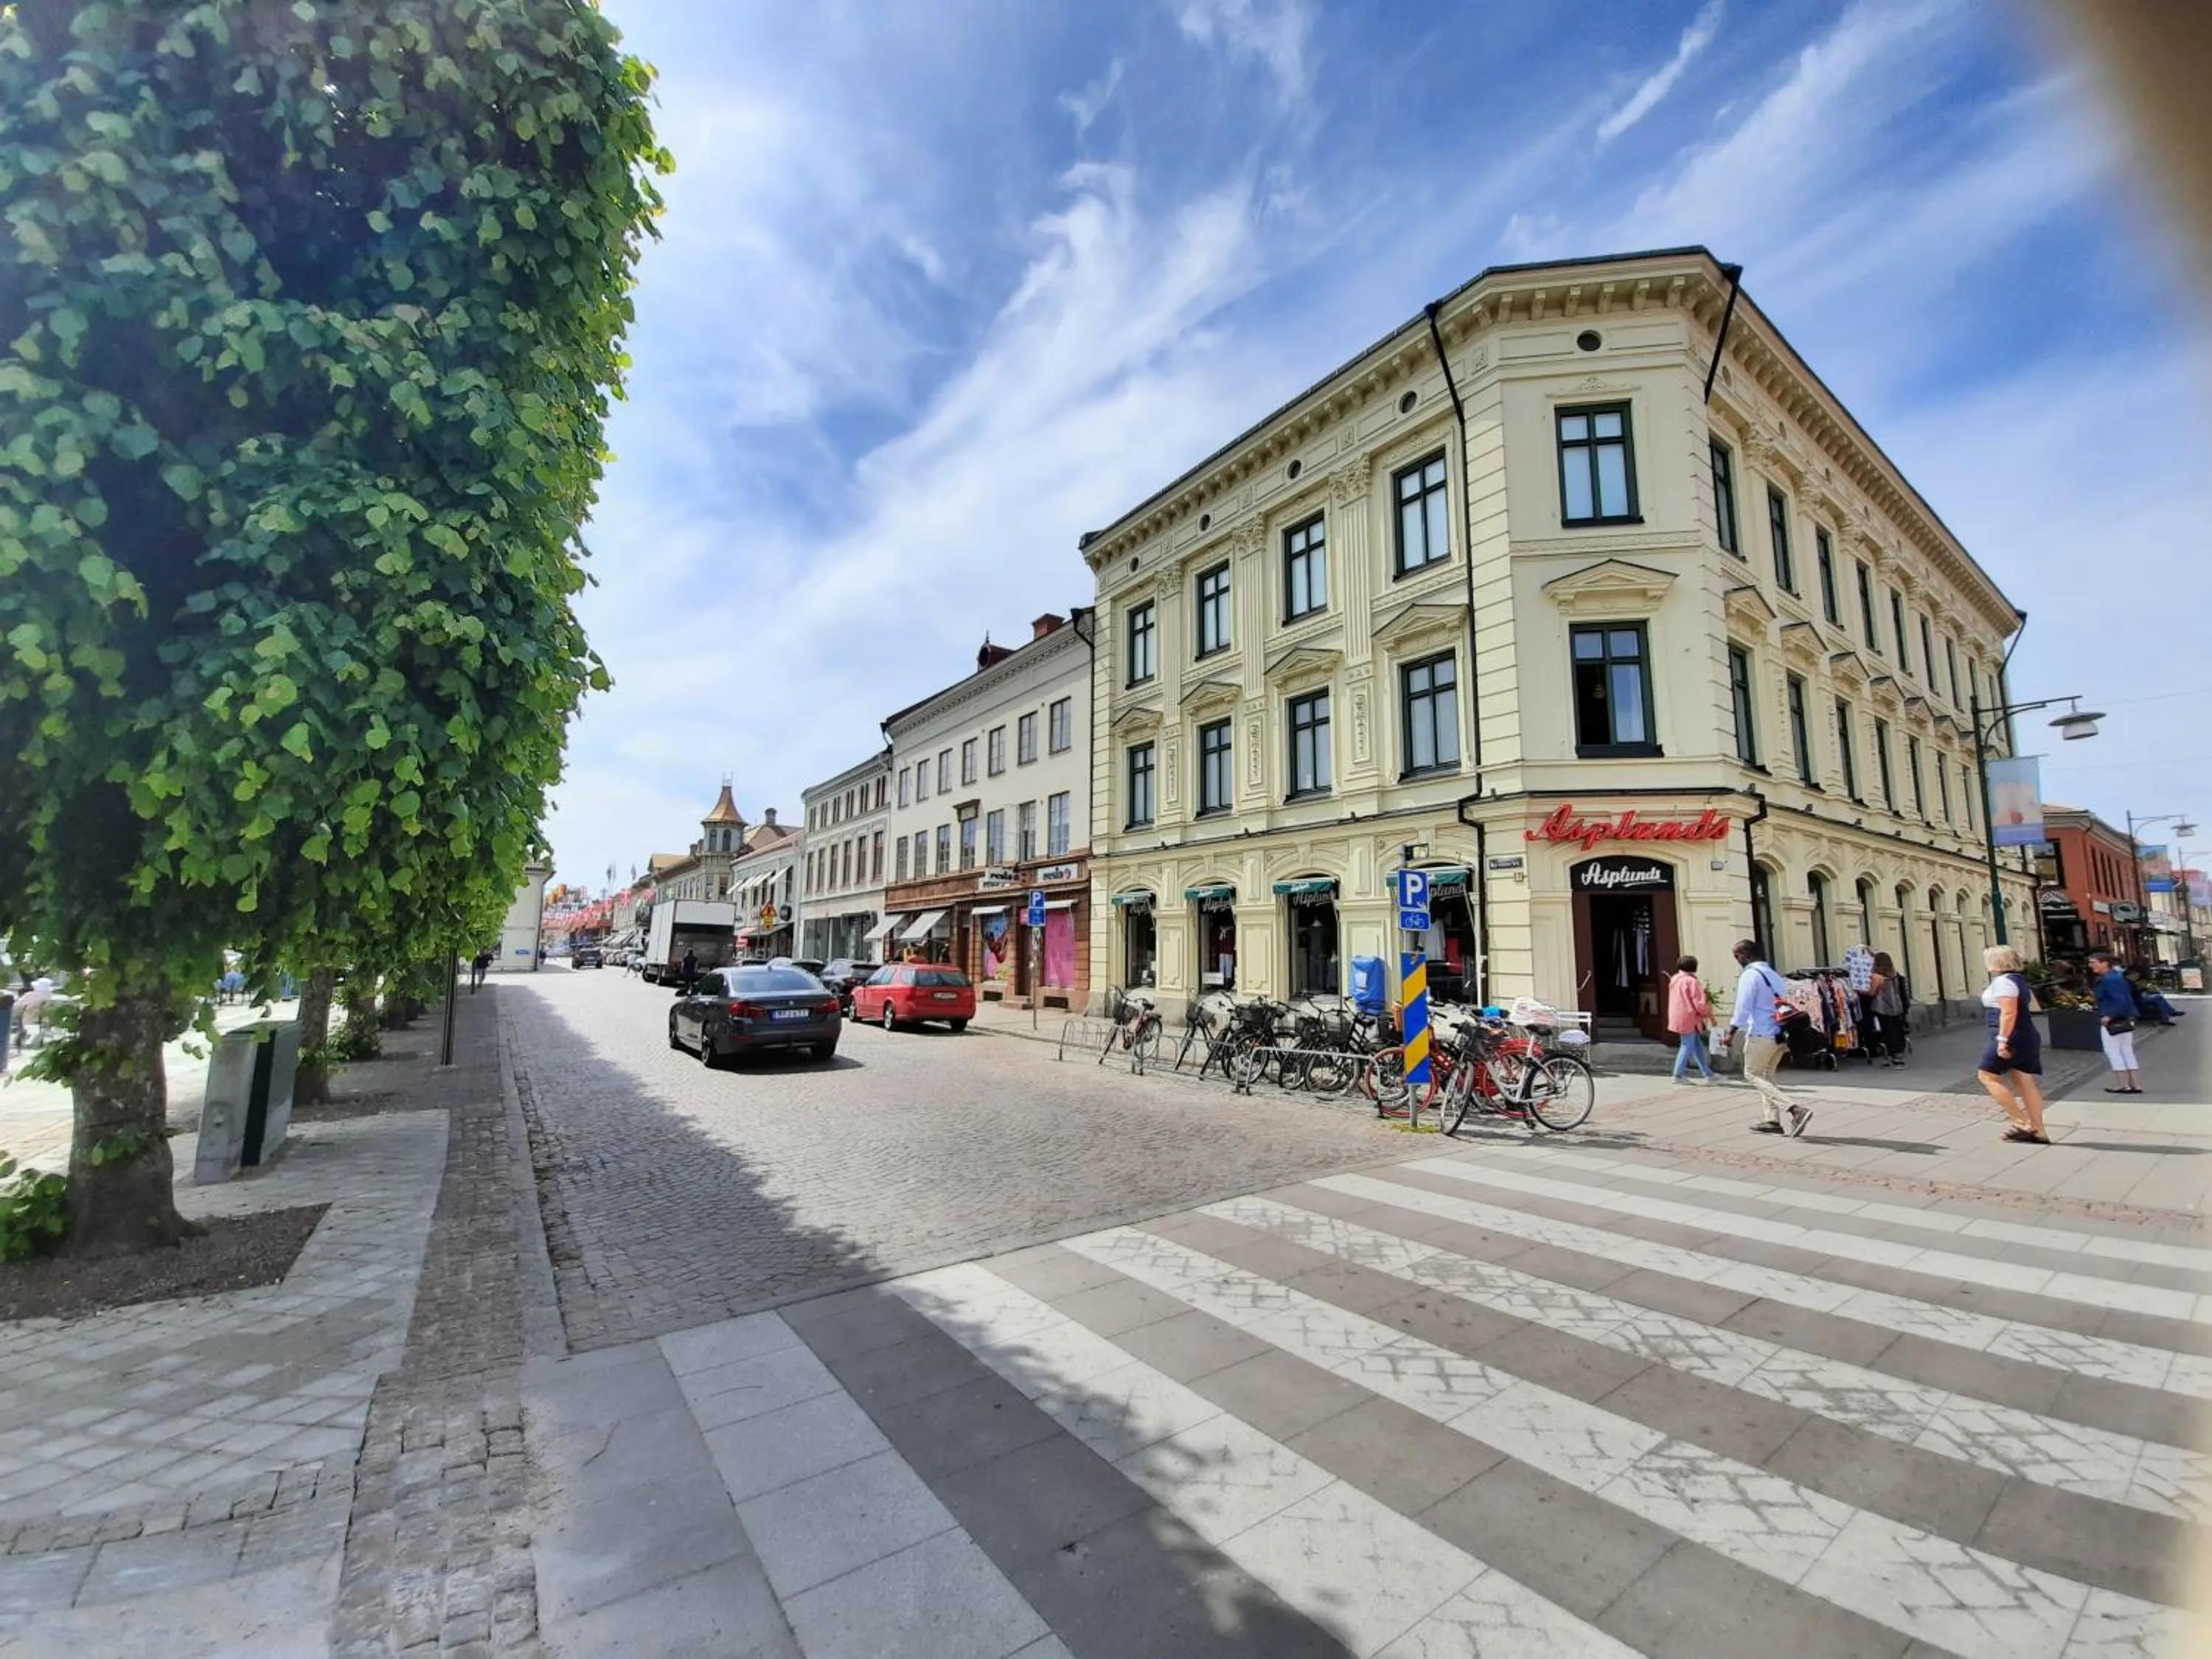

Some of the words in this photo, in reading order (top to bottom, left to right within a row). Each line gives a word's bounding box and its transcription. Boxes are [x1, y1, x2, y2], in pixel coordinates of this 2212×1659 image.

[1524, 804, 1731, 850] Asplunds
[1582, 862, 1666, 888] Asplunds
[1033, 891, 1041, 905] P
[1406, 874, 1423, 905] P
